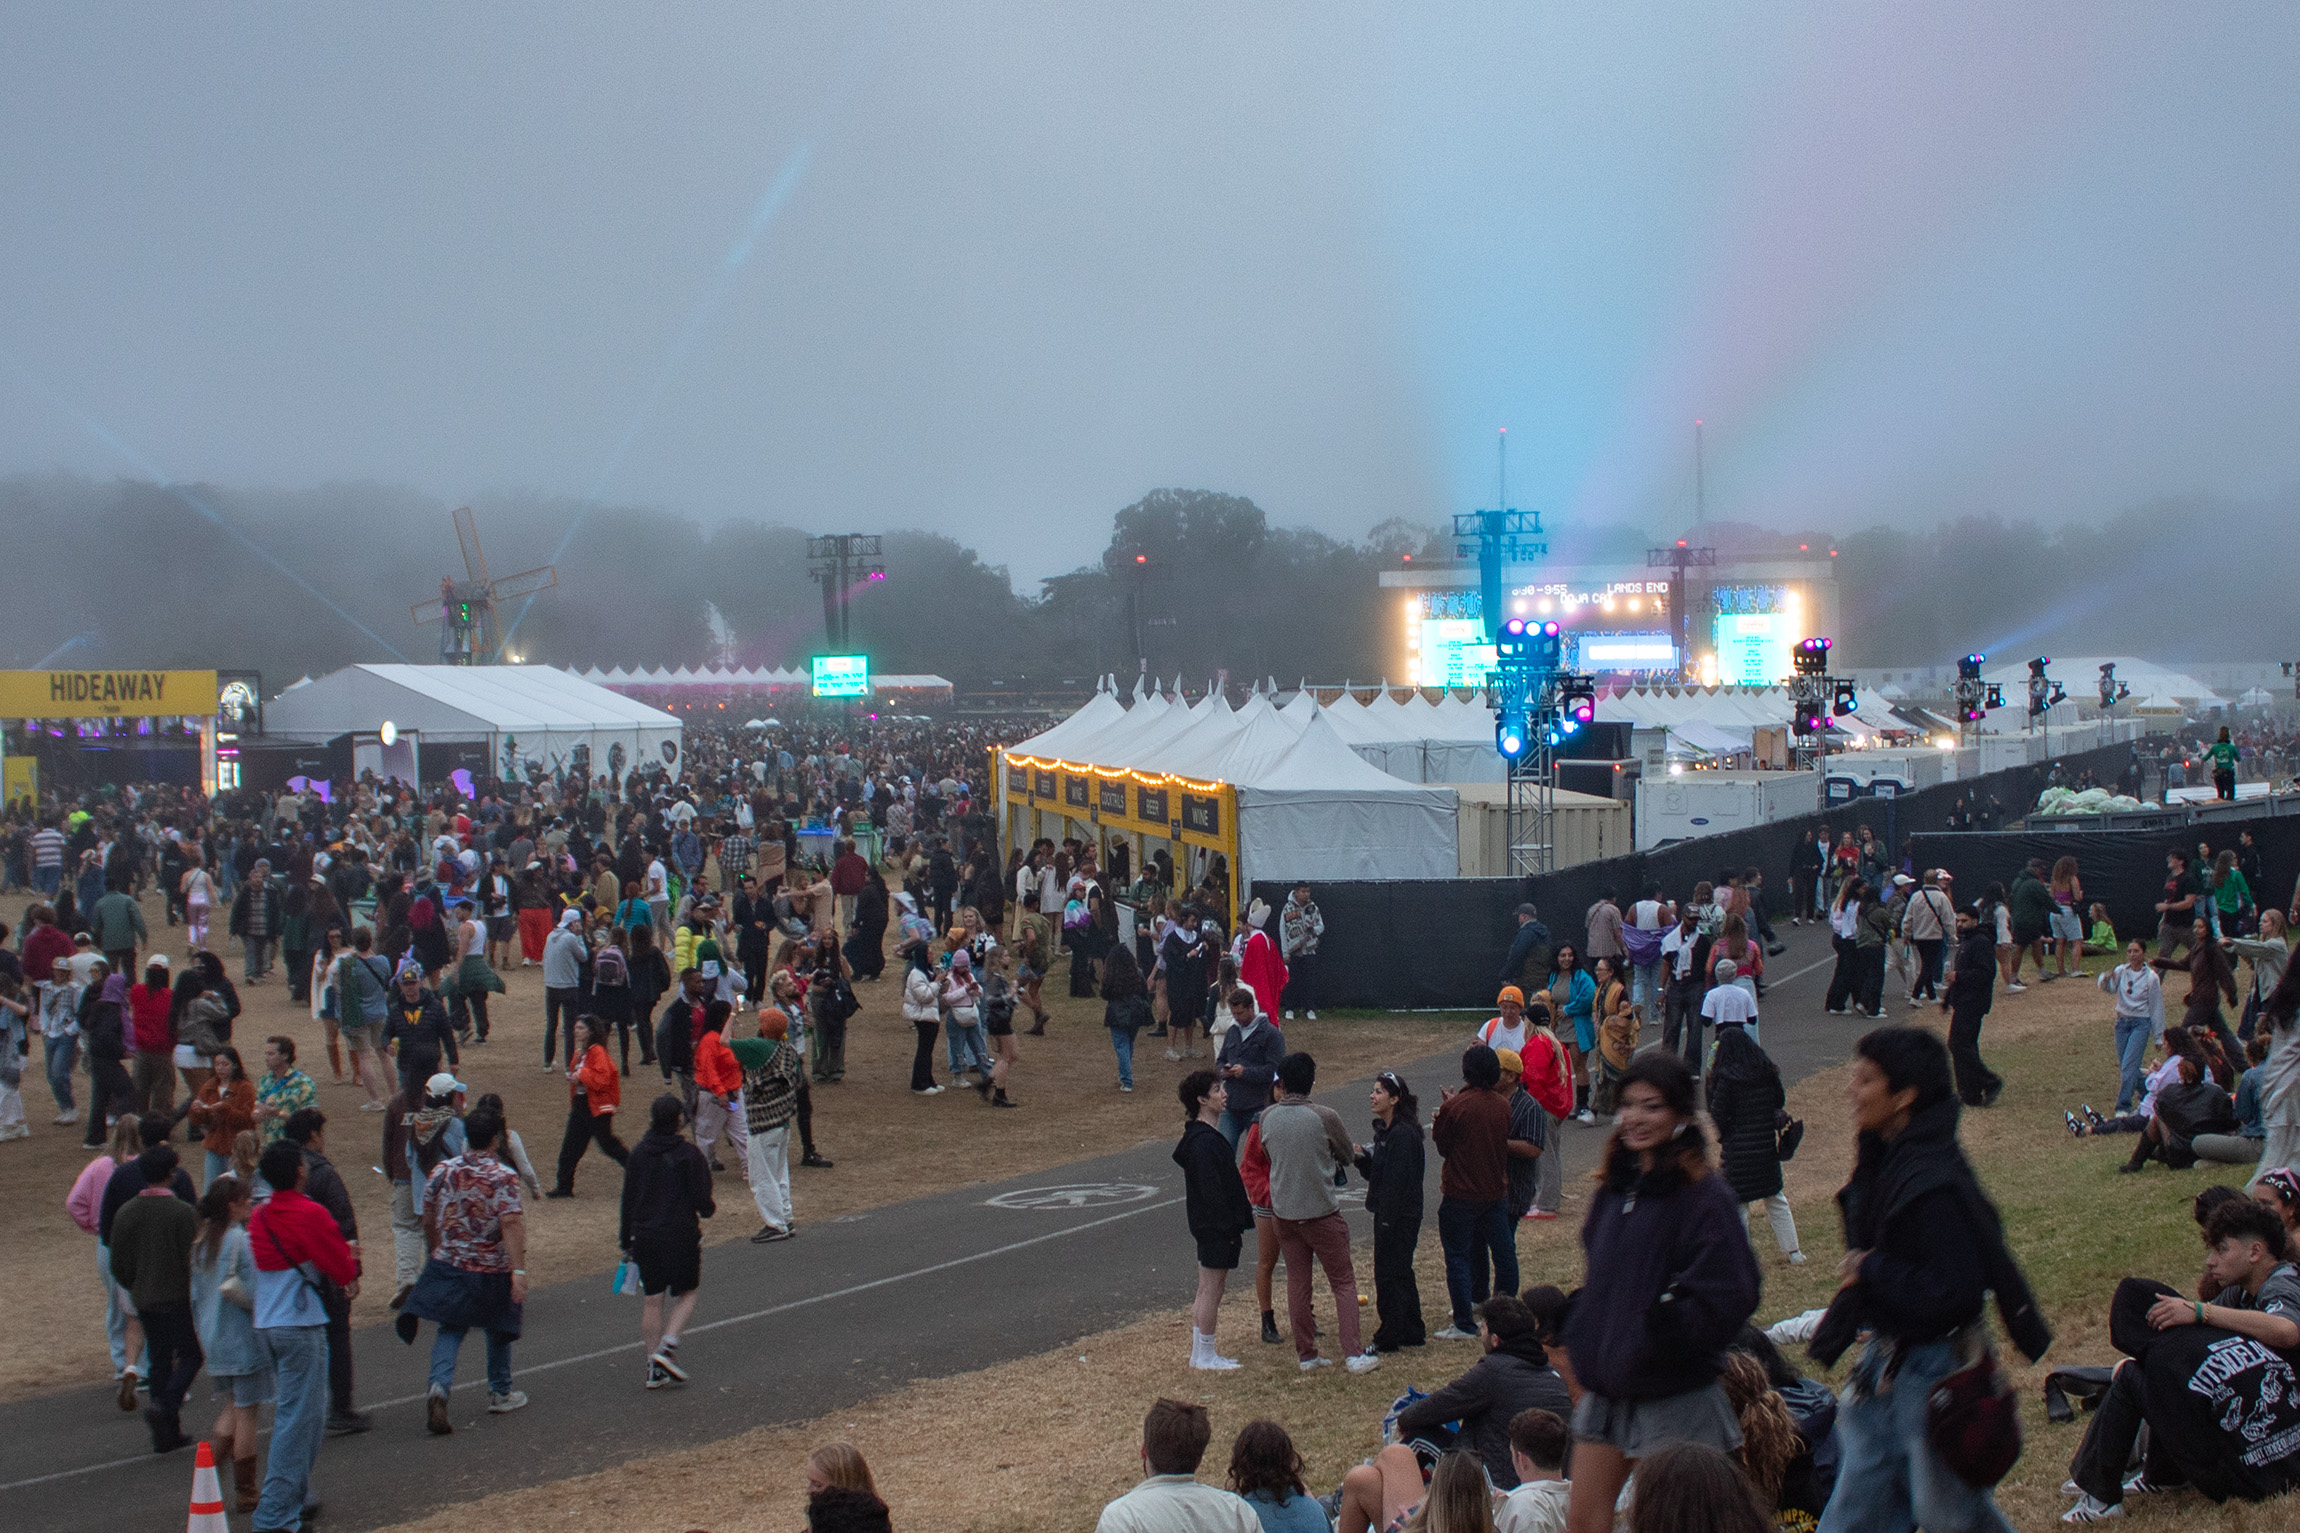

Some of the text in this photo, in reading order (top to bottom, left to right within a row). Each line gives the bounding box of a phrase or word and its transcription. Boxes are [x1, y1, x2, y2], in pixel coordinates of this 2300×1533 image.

[1607, 582, 1669, 594] LANDS END
[1560, 592, 1613, 604] DOJA CAT
[50, 674, 165, 701] HIDEAWAY
[1101, 791, 1124, 810] COCKTAILS
[1146, 798, 1159, 816] BEER
[1192, 806, 1209, 827] WINE
